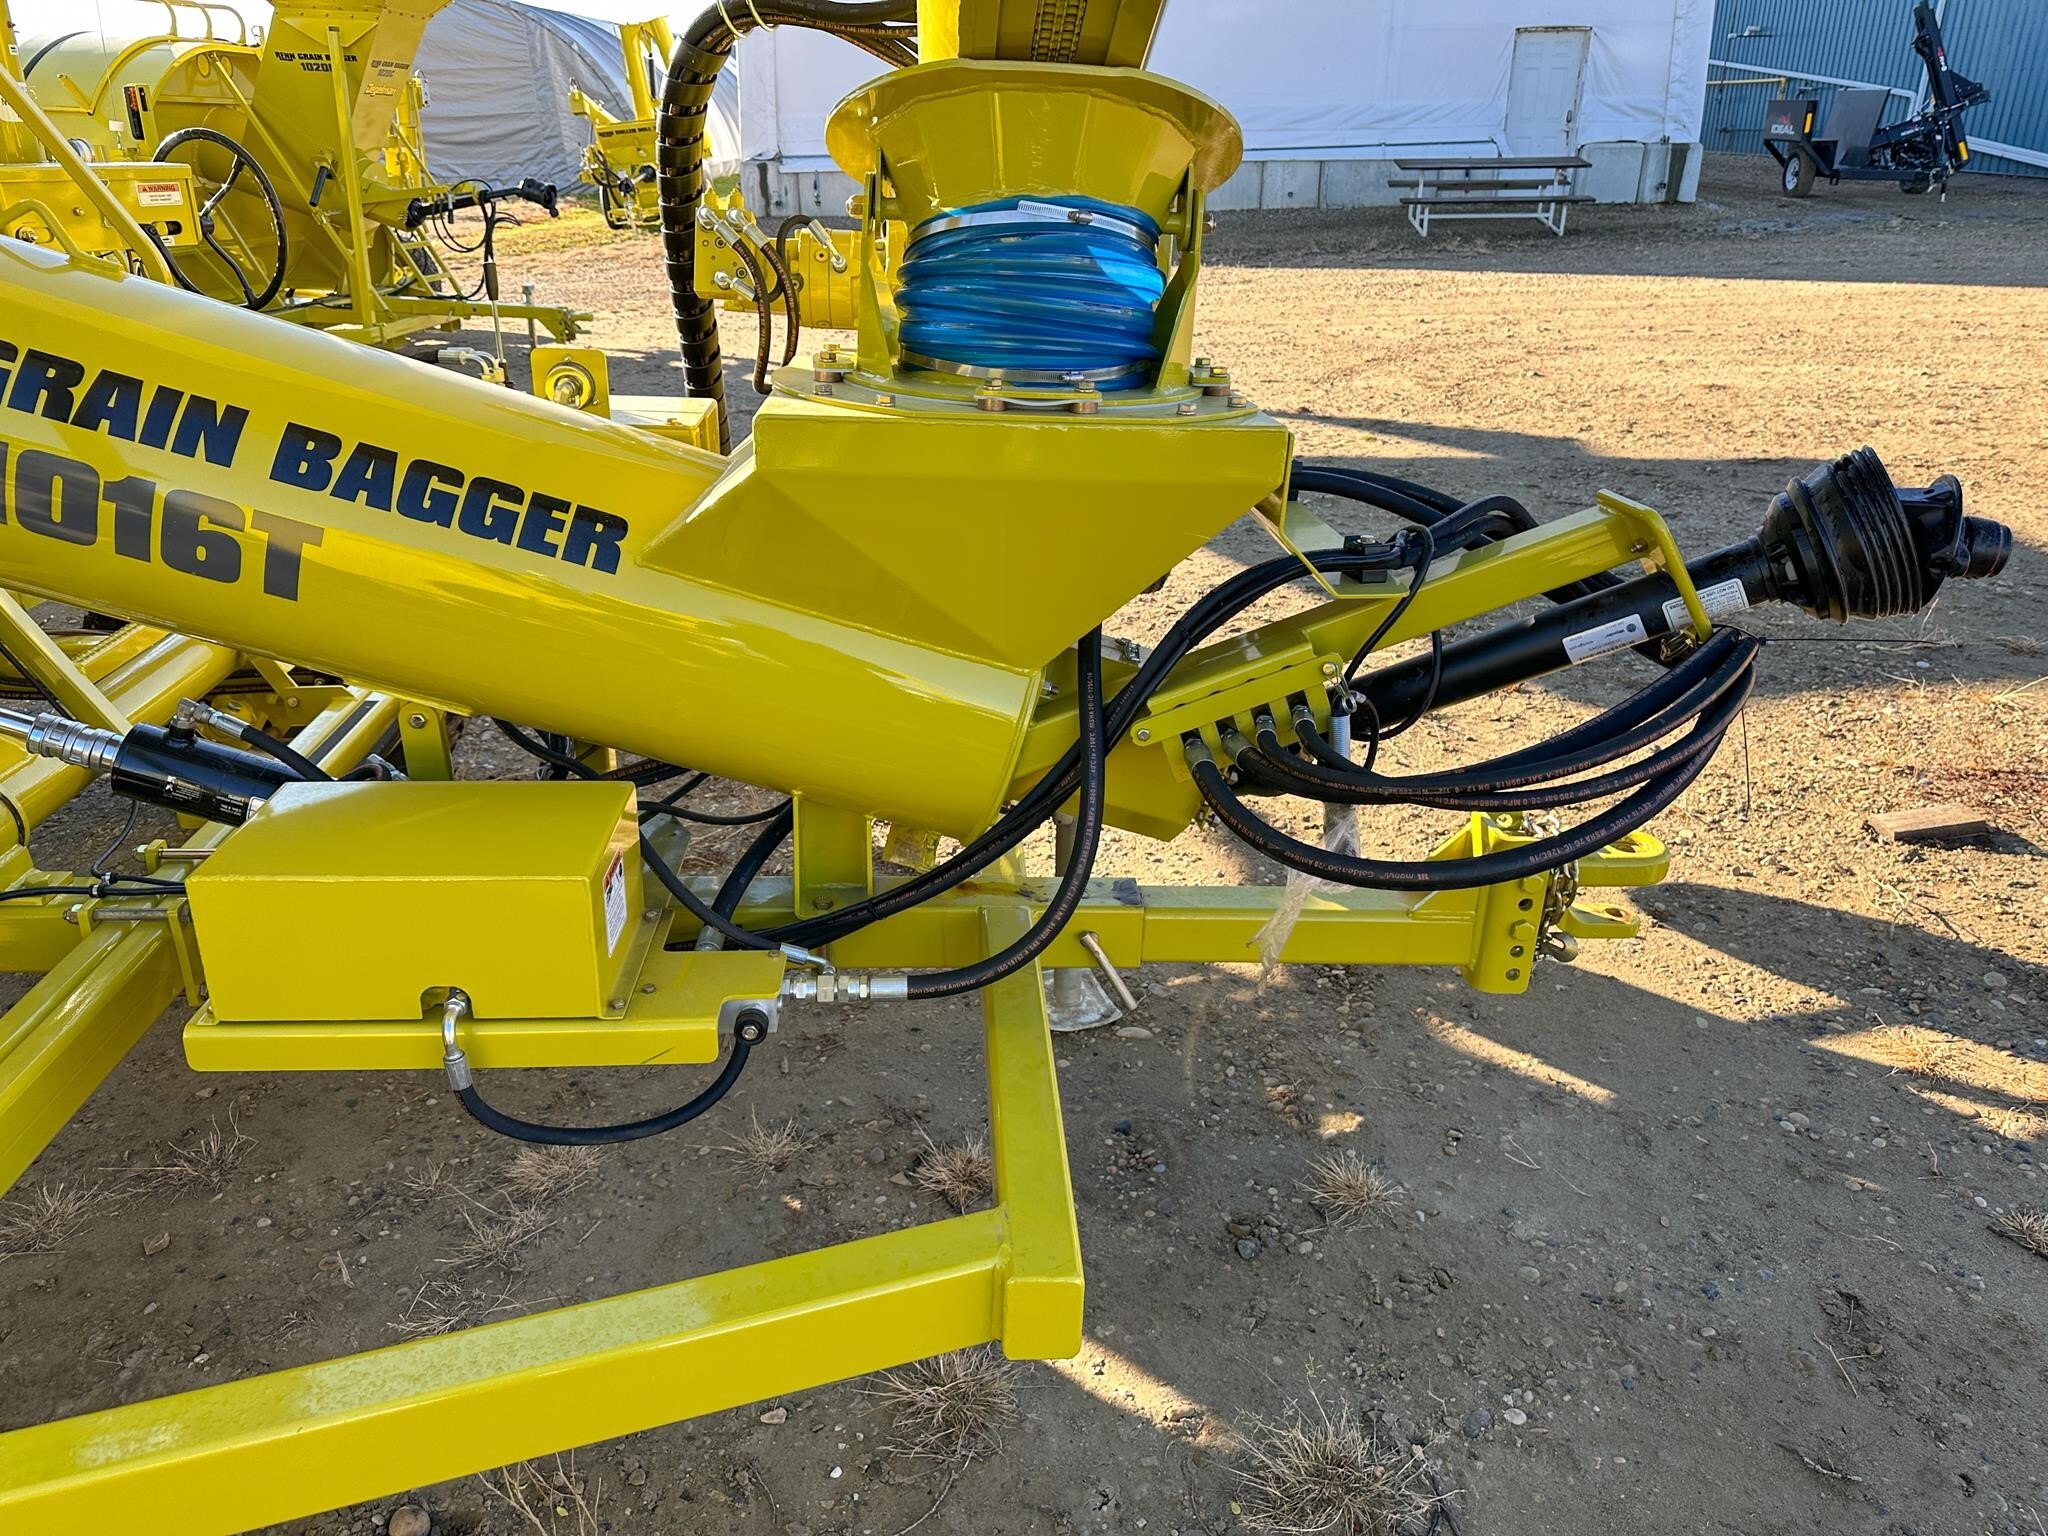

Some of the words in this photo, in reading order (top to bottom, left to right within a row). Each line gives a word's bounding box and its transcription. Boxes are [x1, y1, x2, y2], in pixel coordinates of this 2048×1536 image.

[297, 53, 322, 61] GRAIN
[1770, 123, 1795, 135] IDEAL
[147, 184, 176, 192] WARNING
[0, 341, 250, 468] RAIN
[269, 422, 629, 575] BAGGER
[0, 441, 325, 602] 016T
